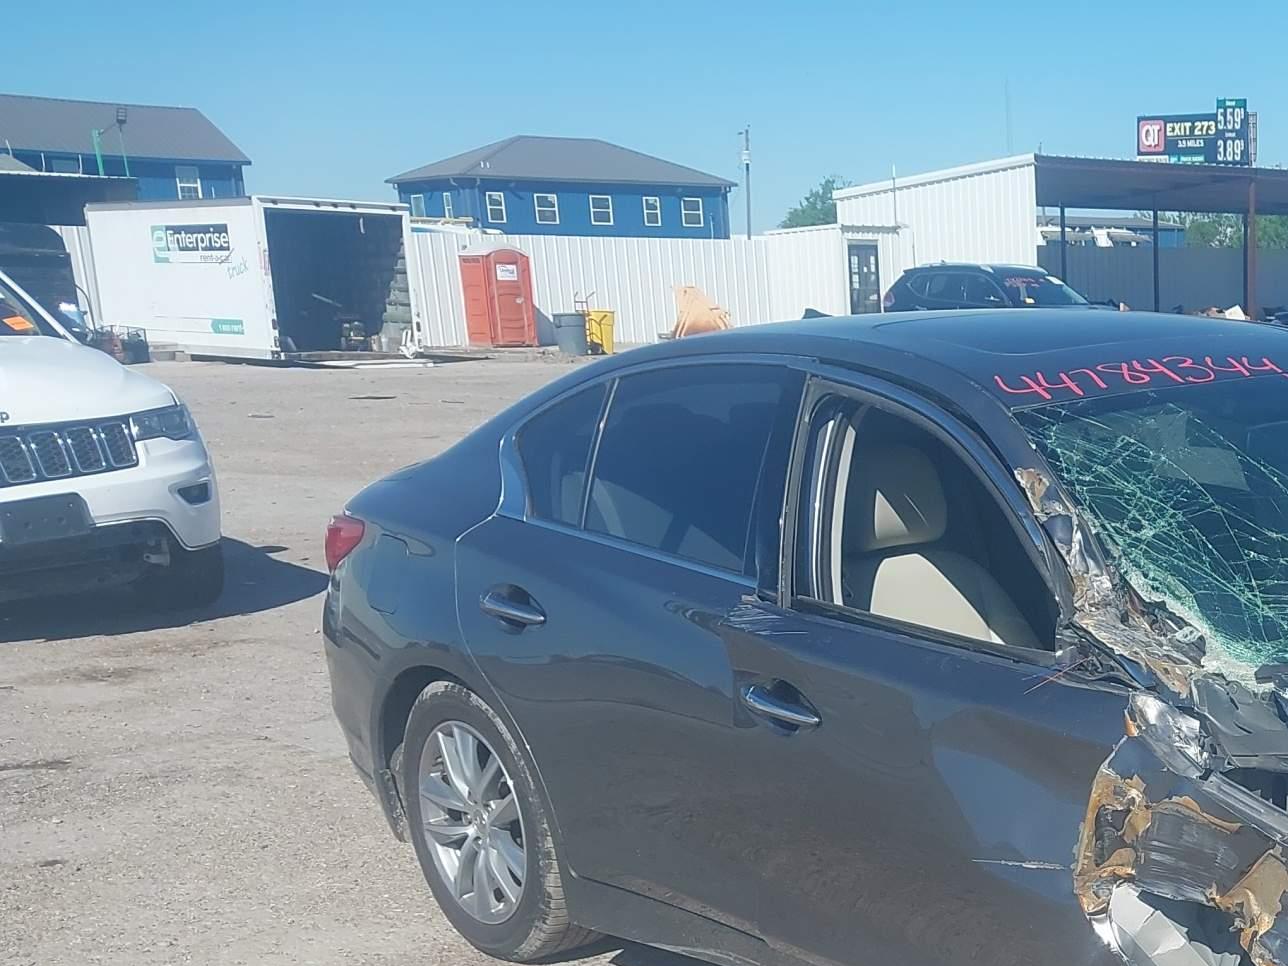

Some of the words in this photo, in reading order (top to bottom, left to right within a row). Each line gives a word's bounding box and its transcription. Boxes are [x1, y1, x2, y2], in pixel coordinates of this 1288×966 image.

[1141, 124, 1161, 147] QT
[1166, 122, 1192, 137] EXIT
[1194, 120, 1216, 135] 273
[1187, 139, 1204, 148] MILES
[166, 227, 229, 251] Enterprise
